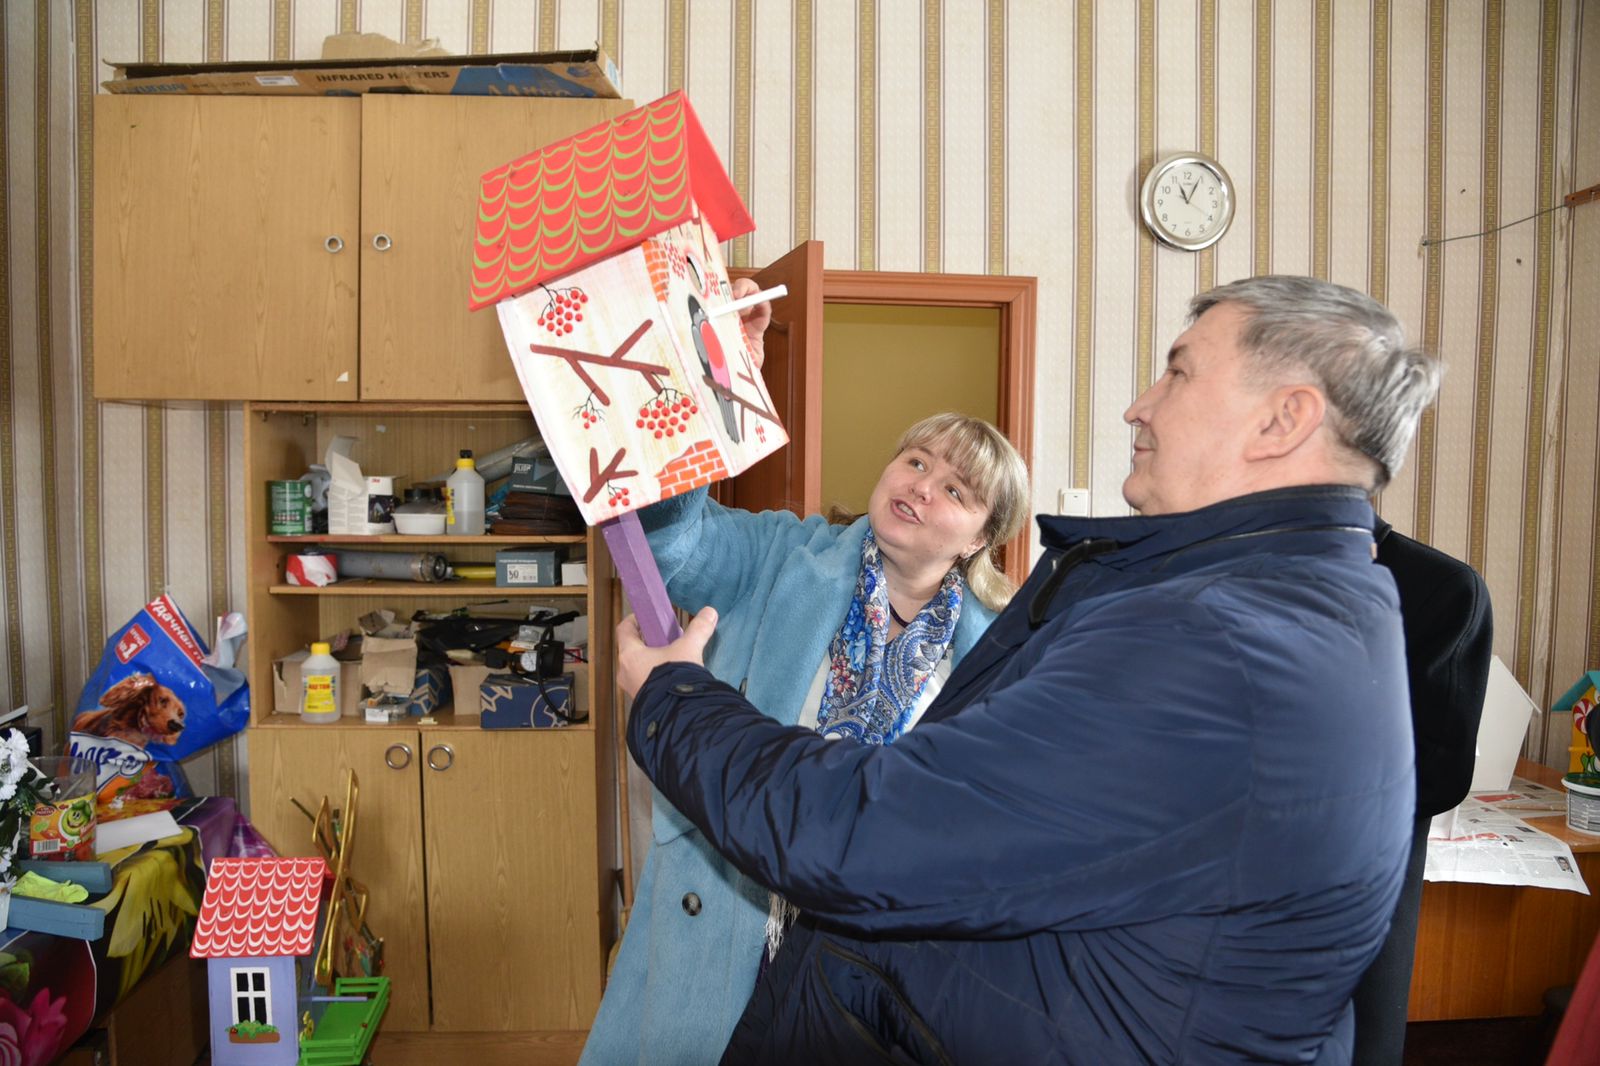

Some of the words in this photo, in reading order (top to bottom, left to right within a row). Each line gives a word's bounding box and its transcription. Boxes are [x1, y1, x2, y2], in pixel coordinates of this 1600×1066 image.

[316, 73, 384, 83] INFRARED
[387, 71, 450, 80] HTERS
[1172, 175, 1178, 184] 11
[1183, 171, 1192, 180] 12
[1162, 186, 1171, 194] 10
[1209, 187, 1215, 195] 2
[1157, 199, 1163, 207] 9
[1212, 200, 1218, 209] 3
[1162, 213, 1168, 222] 8
[1172, 224, 1177, 232] 7
[1185, 228, 1191, 237] 6
[1199, 224, 1205, 233] 5
[150, 597, 193, 649] Удачная
